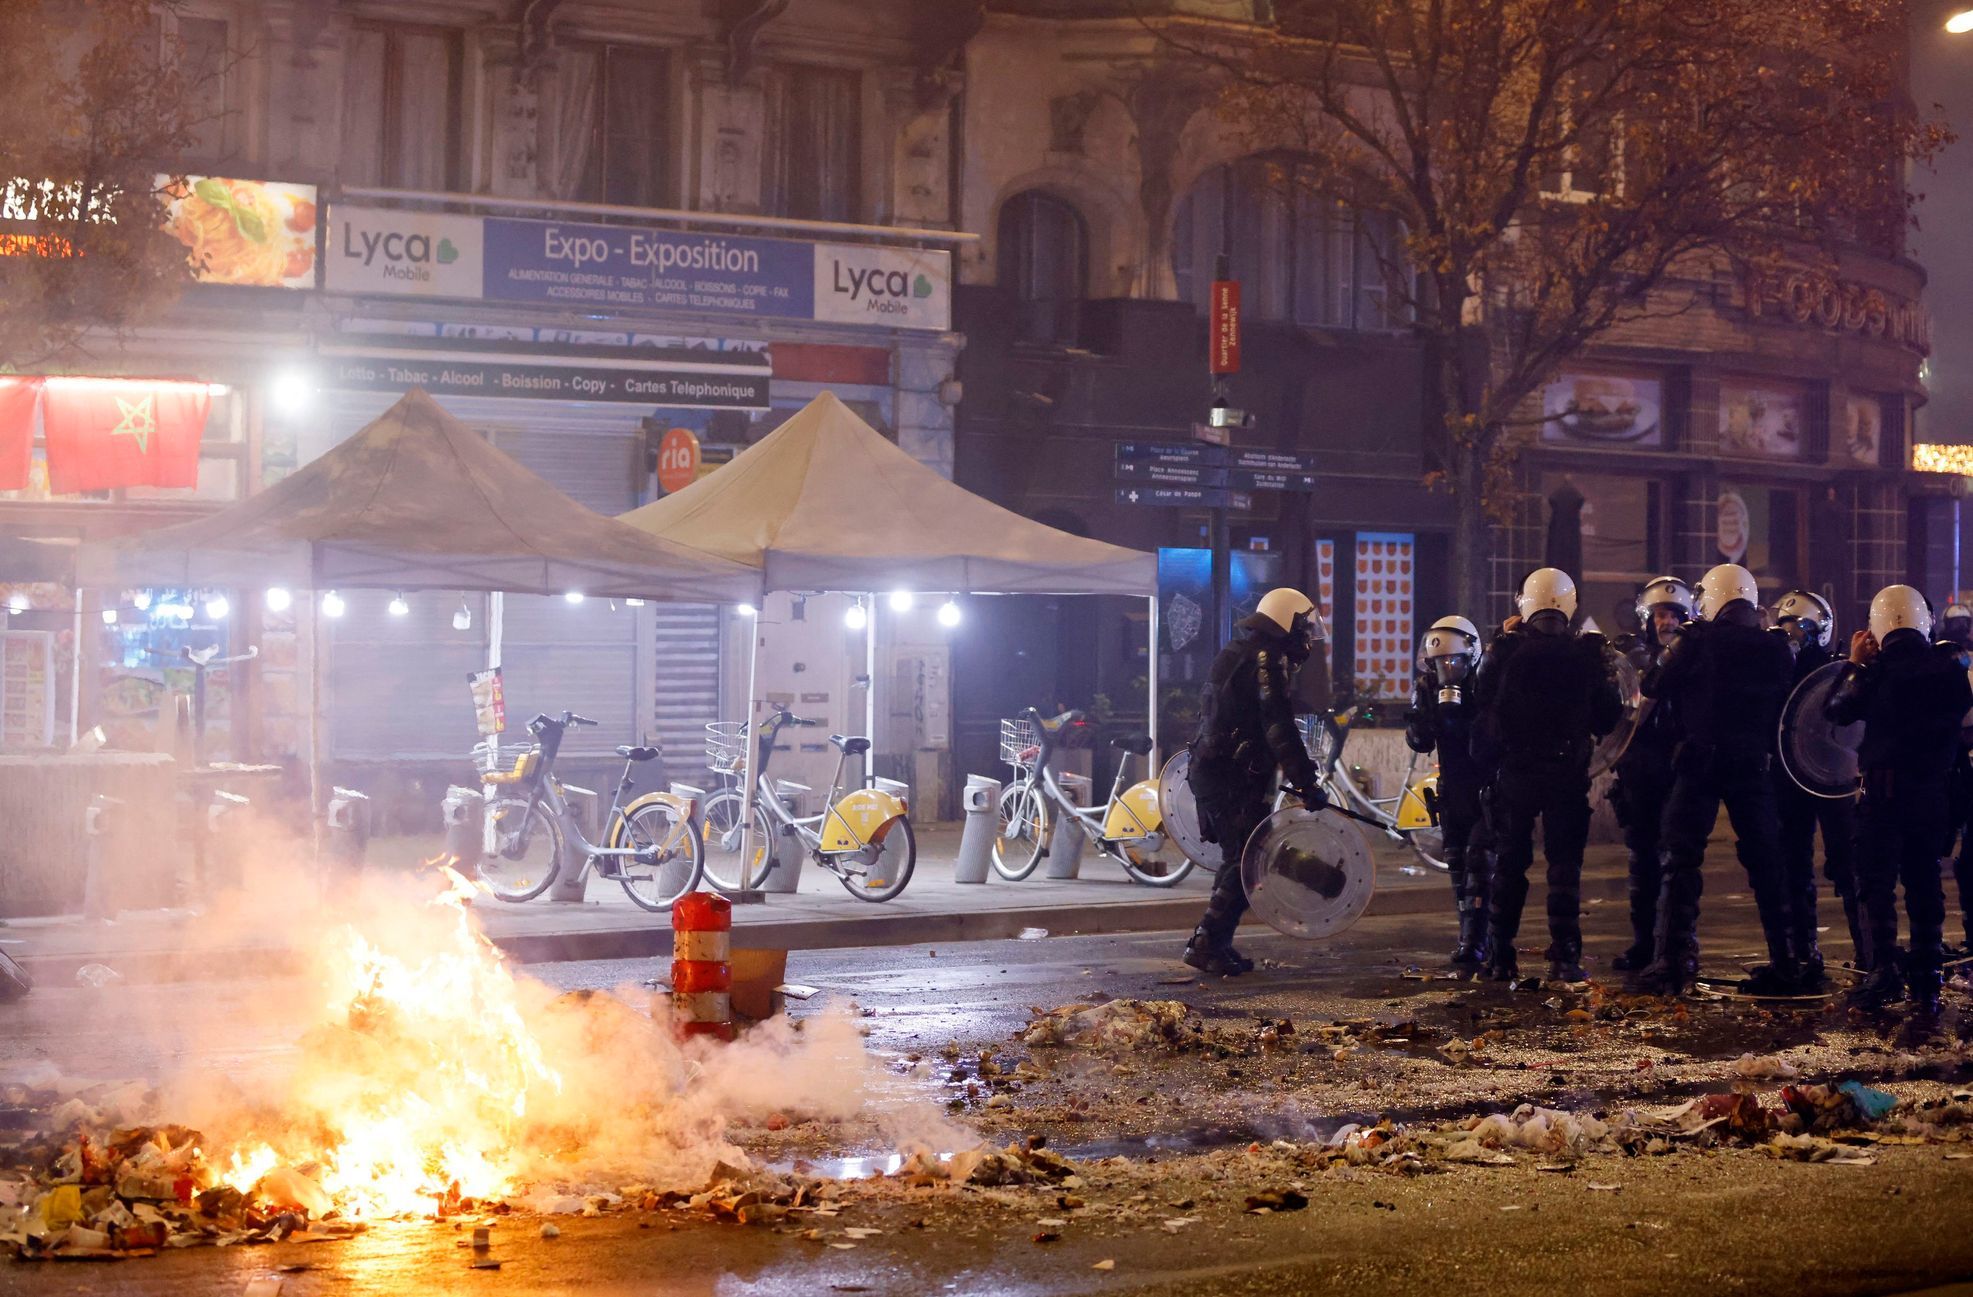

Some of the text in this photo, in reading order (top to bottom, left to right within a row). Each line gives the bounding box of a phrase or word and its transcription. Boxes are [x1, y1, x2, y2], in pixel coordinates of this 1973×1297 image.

[344, 221, 431, 266] Lyca
[544, 227, 609, 268] Expo
[630, 234, 759, 273] Exposition
[382, 264, 431, 282] Mobile
[508, 268, 568, 284] ALIMENTATION
[570, 272, 614, 287] GENERALE
[621, 276, 647, 289] TABAC
[654, 278, 687, 291] ALCOOL
[694, 280, 736, 294] BOISSONS
[774, 286, 789, 298] FAX
[833, 259, 908, 300] Lyca
[546, 286, 755, 310] ACCESSOIRES MOBILES CARTES TELEPHONIQUES
[866, 299, 908, 315] Mobile
[339, 365, 375, 382] Lotto
[387, 367, 428, 385] Tabac
[440, 370, 484, 386] Alcool
[502, 373, 560, 390] Boission
[572, 376, 606, 394] Copy
[625, 378, 667, 395] Cartes
[670, 380, 755, 399] Telephonique
[661, 436, 691, 471] ria
